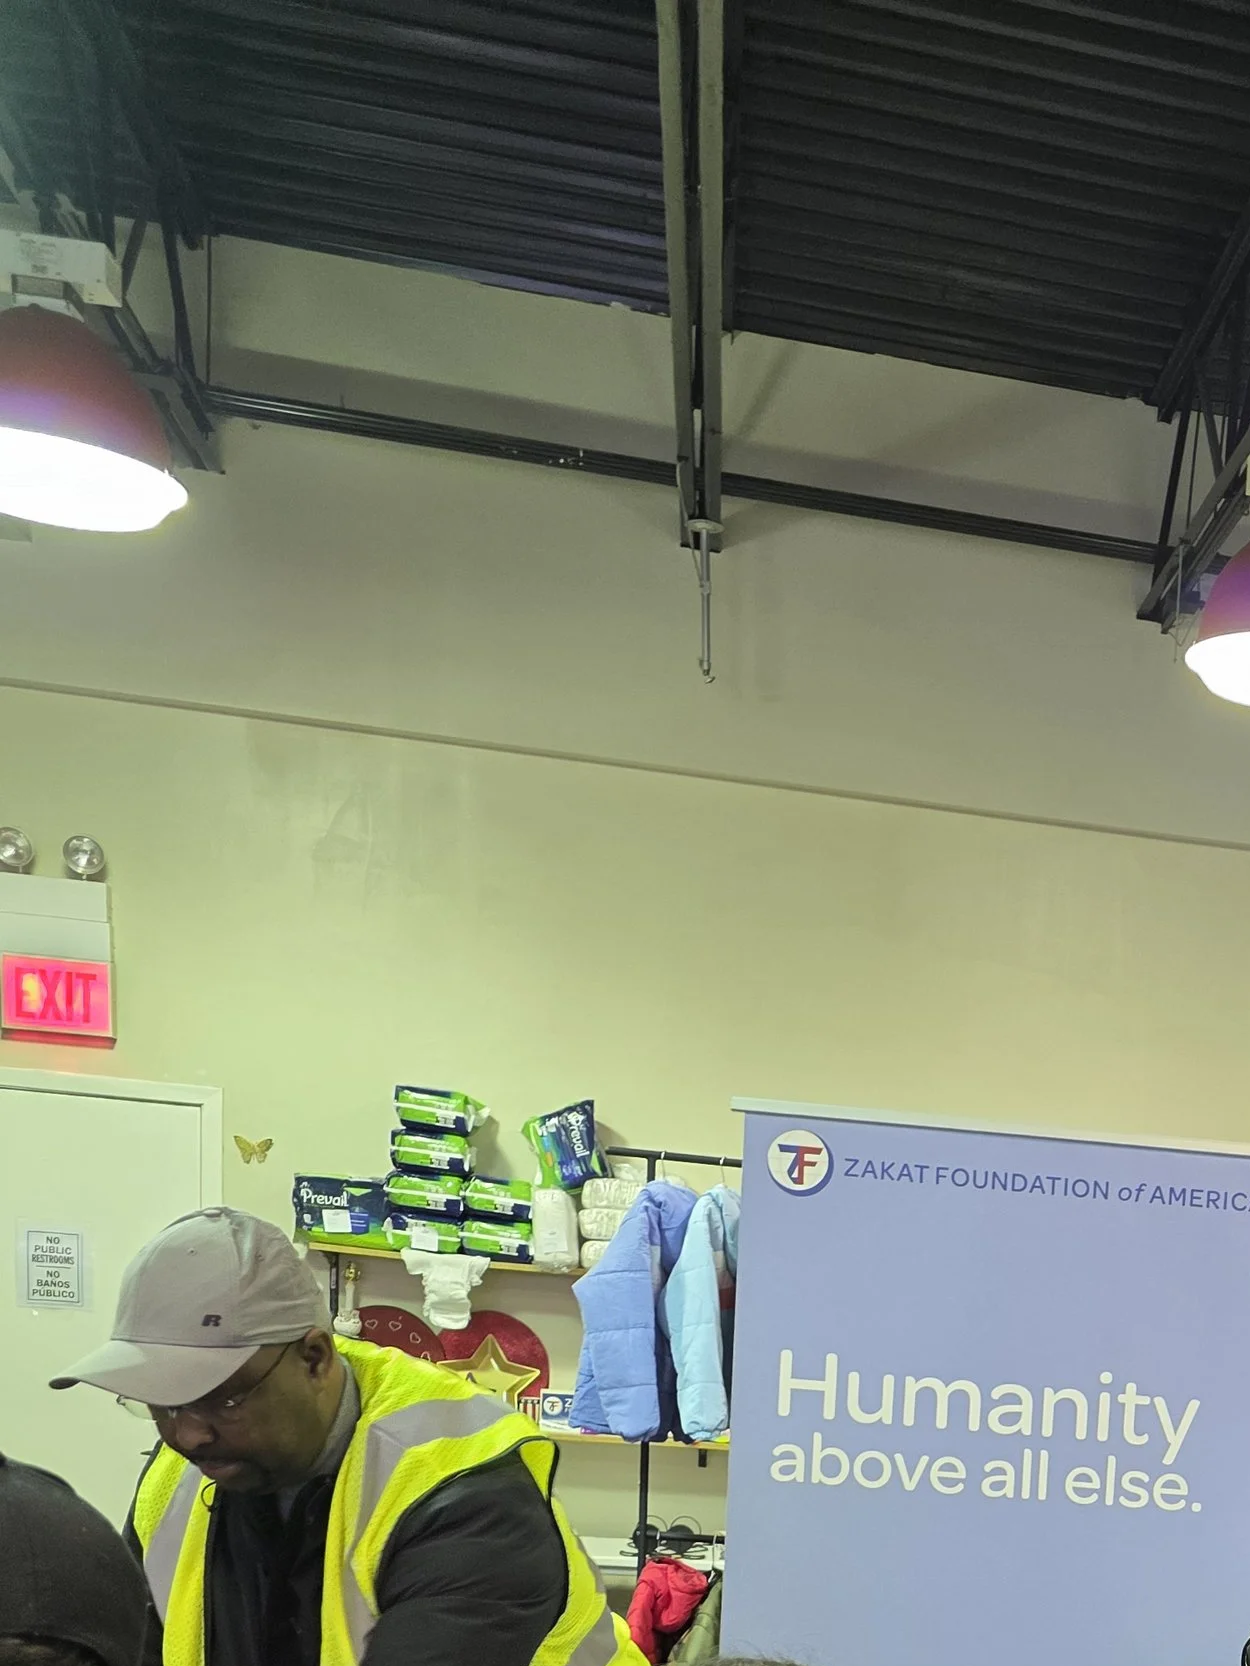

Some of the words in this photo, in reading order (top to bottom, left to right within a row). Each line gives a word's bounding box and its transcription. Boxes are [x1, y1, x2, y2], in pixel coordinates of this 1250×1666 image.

[15, 967, 97, 1024] EXIT
[843, 1157, 930, 1185] ZAKAT
[935, 1166, 1110, 1201] FOUNDATION
[1118, 1183, 1147, 1203] of
[299, 1187, 349, 1208] Prevail
[46, 1236, 60, 1245] NO
[34, 1245, 72, 1255] PUBLIC
[31, 1253, 75, 1265] RESTROOMS
[46, 1270, 60, 1279] NO
[36, 1278, 70, 1289] BAÑOS
[777, 1349, 1201, 1465] Humanity
[769, 1432, 967, 1495] above
[981, 1448, 1048, 1501] all
[1065, 1455, 1202, 1513] else.
